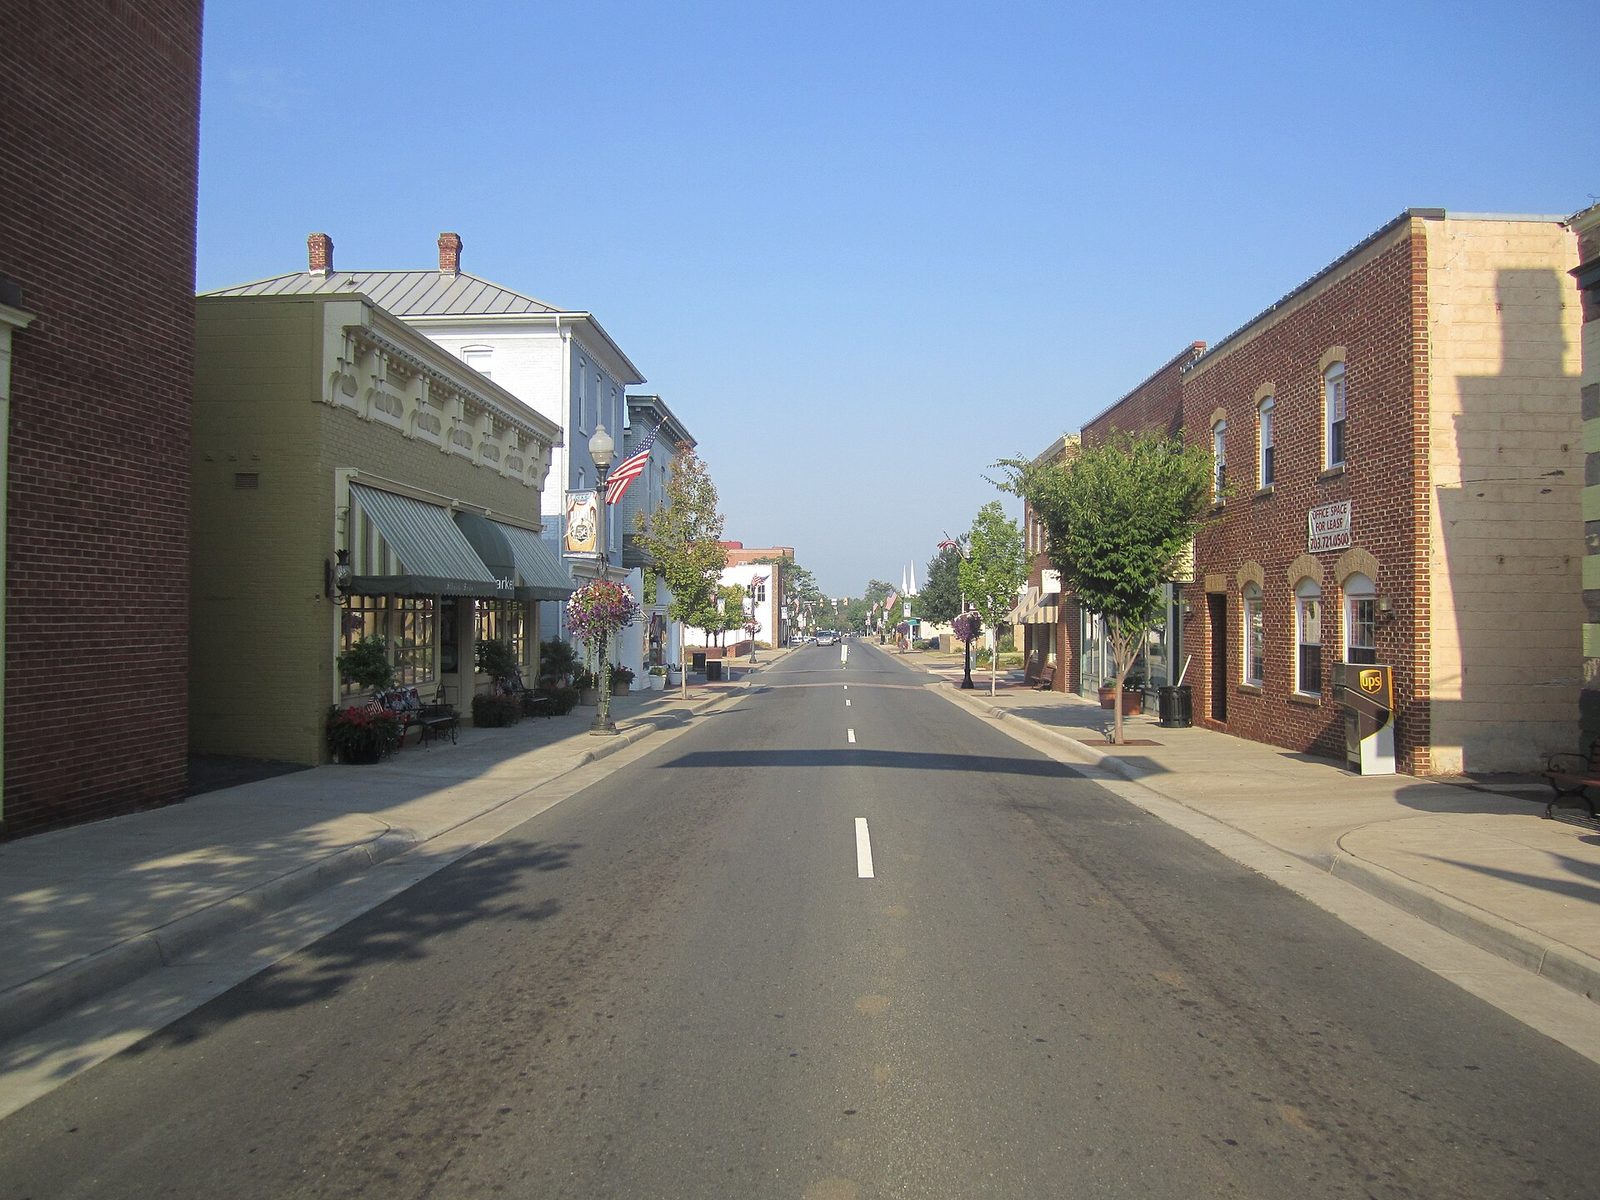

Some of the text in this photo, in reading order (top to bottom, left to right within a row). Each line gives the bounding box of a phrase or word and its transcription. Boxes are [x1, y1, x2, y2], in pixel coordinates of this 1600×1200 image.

[1312, 504, 1347, 520] OFFICE SPACE
[1315, 517, 1343, 532] FOR LEASE
[1362, 676, 1381, 690] ups
